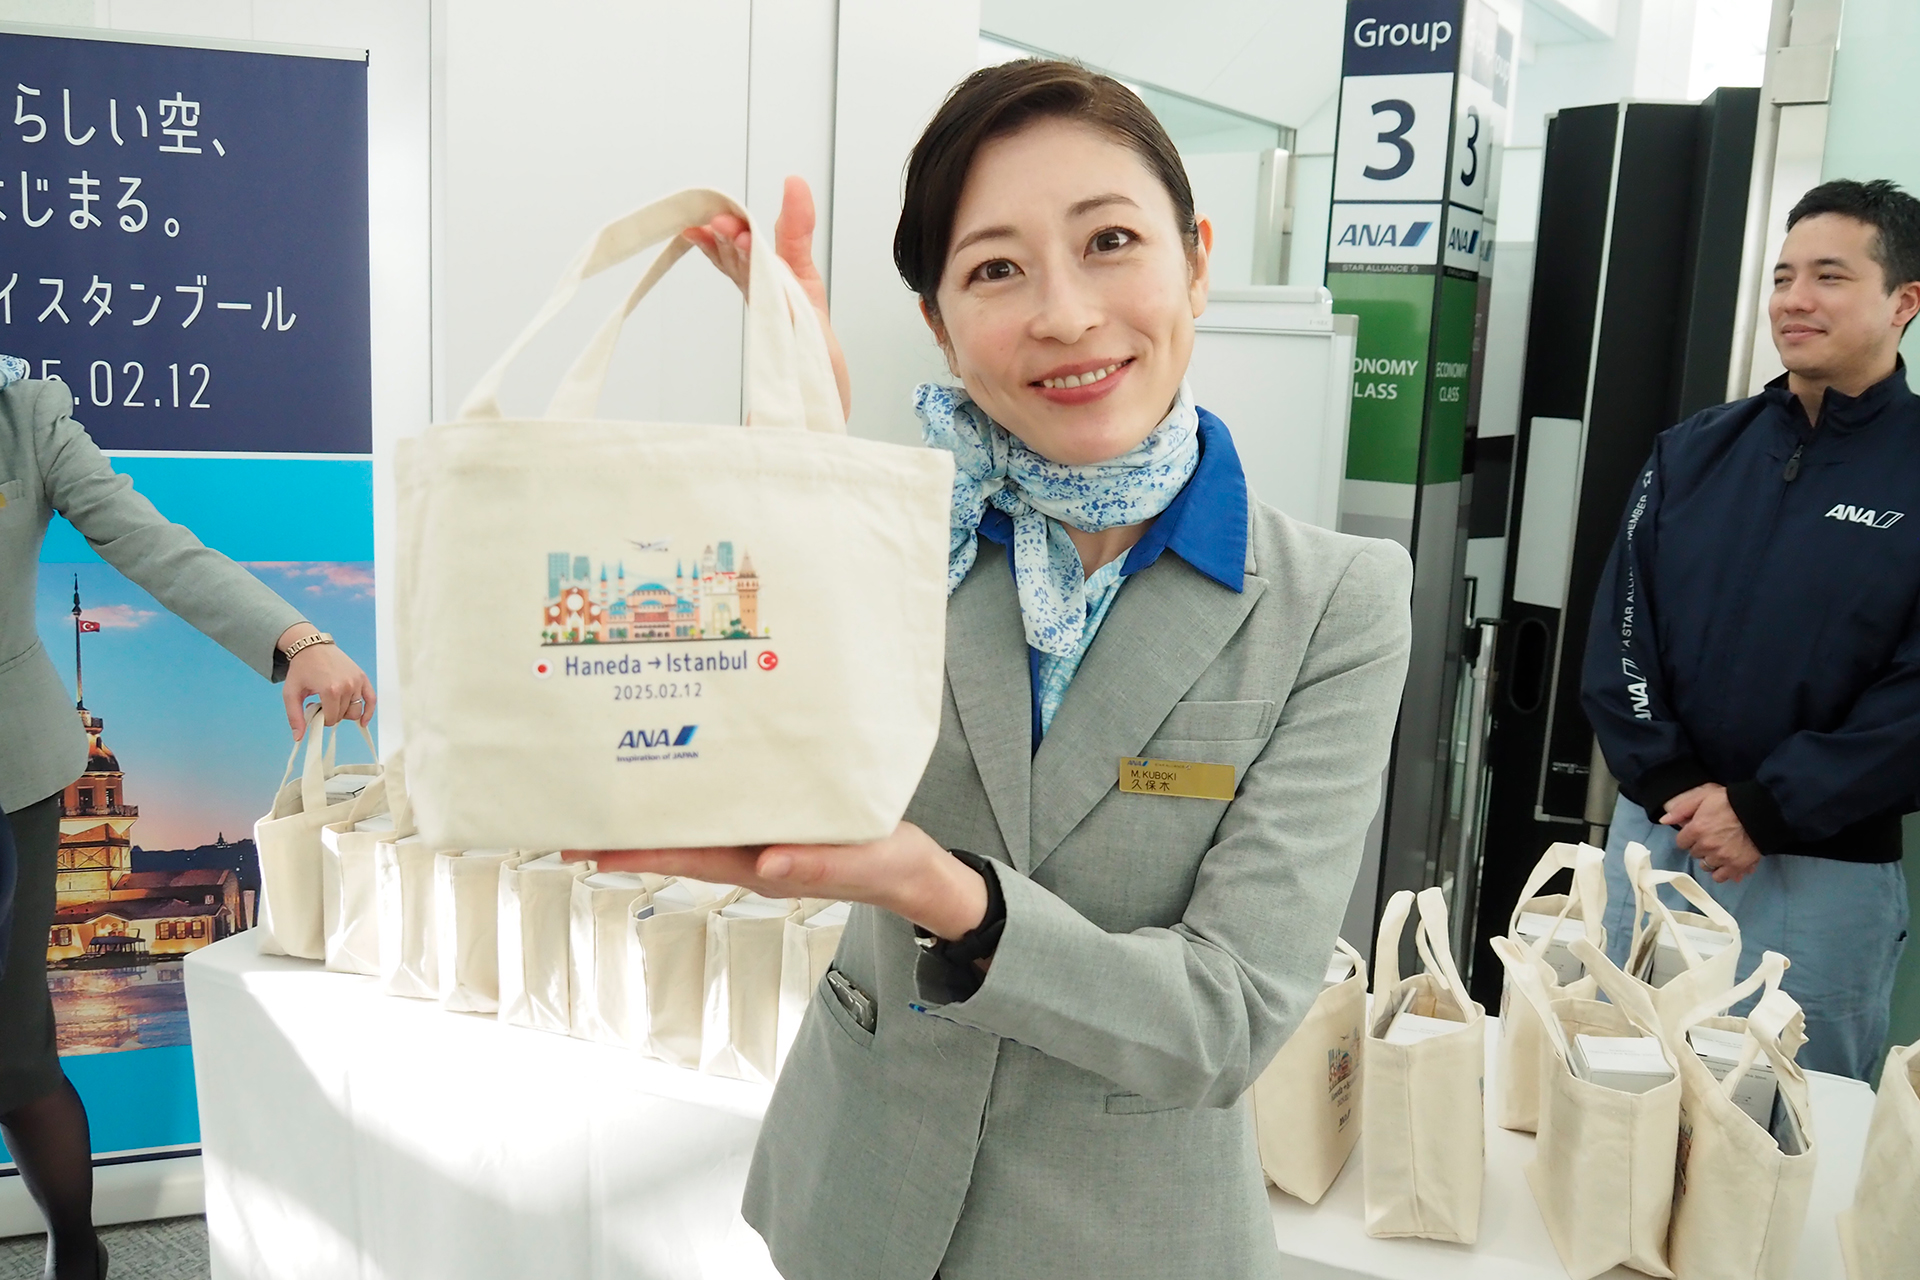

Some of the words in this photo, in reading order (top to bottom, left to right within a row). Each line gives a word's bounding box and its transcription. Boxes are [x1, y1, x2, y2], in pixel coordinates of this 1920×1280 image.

[1353, 18, 1452, 52] Group
[1362, 98, 1416, 181] 3
[1460, 105, 1480, 187] 3
[1337, 223, 1398, 247] ANA
[1342, 264, 1365, 272] STAR
[1366, 264, 1409, 273] ALLIANCE
[0, 273, 297, 332] イスタンブール
[1353, 358, 1419, 376] ONOMY
[1435, 361, 1468, 379] ECONOMY
[22, 358, 211, 409] .02.12
[1354, 382, 1398, 400] LASS
[1439, 386, 1460, 402] CLASS
[1824, 503, 1877, 527] ANA
[1622, 606, 1635, 637] STAR
[565, 654, 642, 676] Haneda
[666, 650, 748, 673] Istanbul
[613, 682, 703, 701] 2025.02.12
[617, 728, 671, 749] ANA
[616, 753, 661, 763] Inspiration
[662, 752, 671, 761] of
[672, 751, 699, 760] JAPAN
[1131, 779, 1171, 792] 久保木
